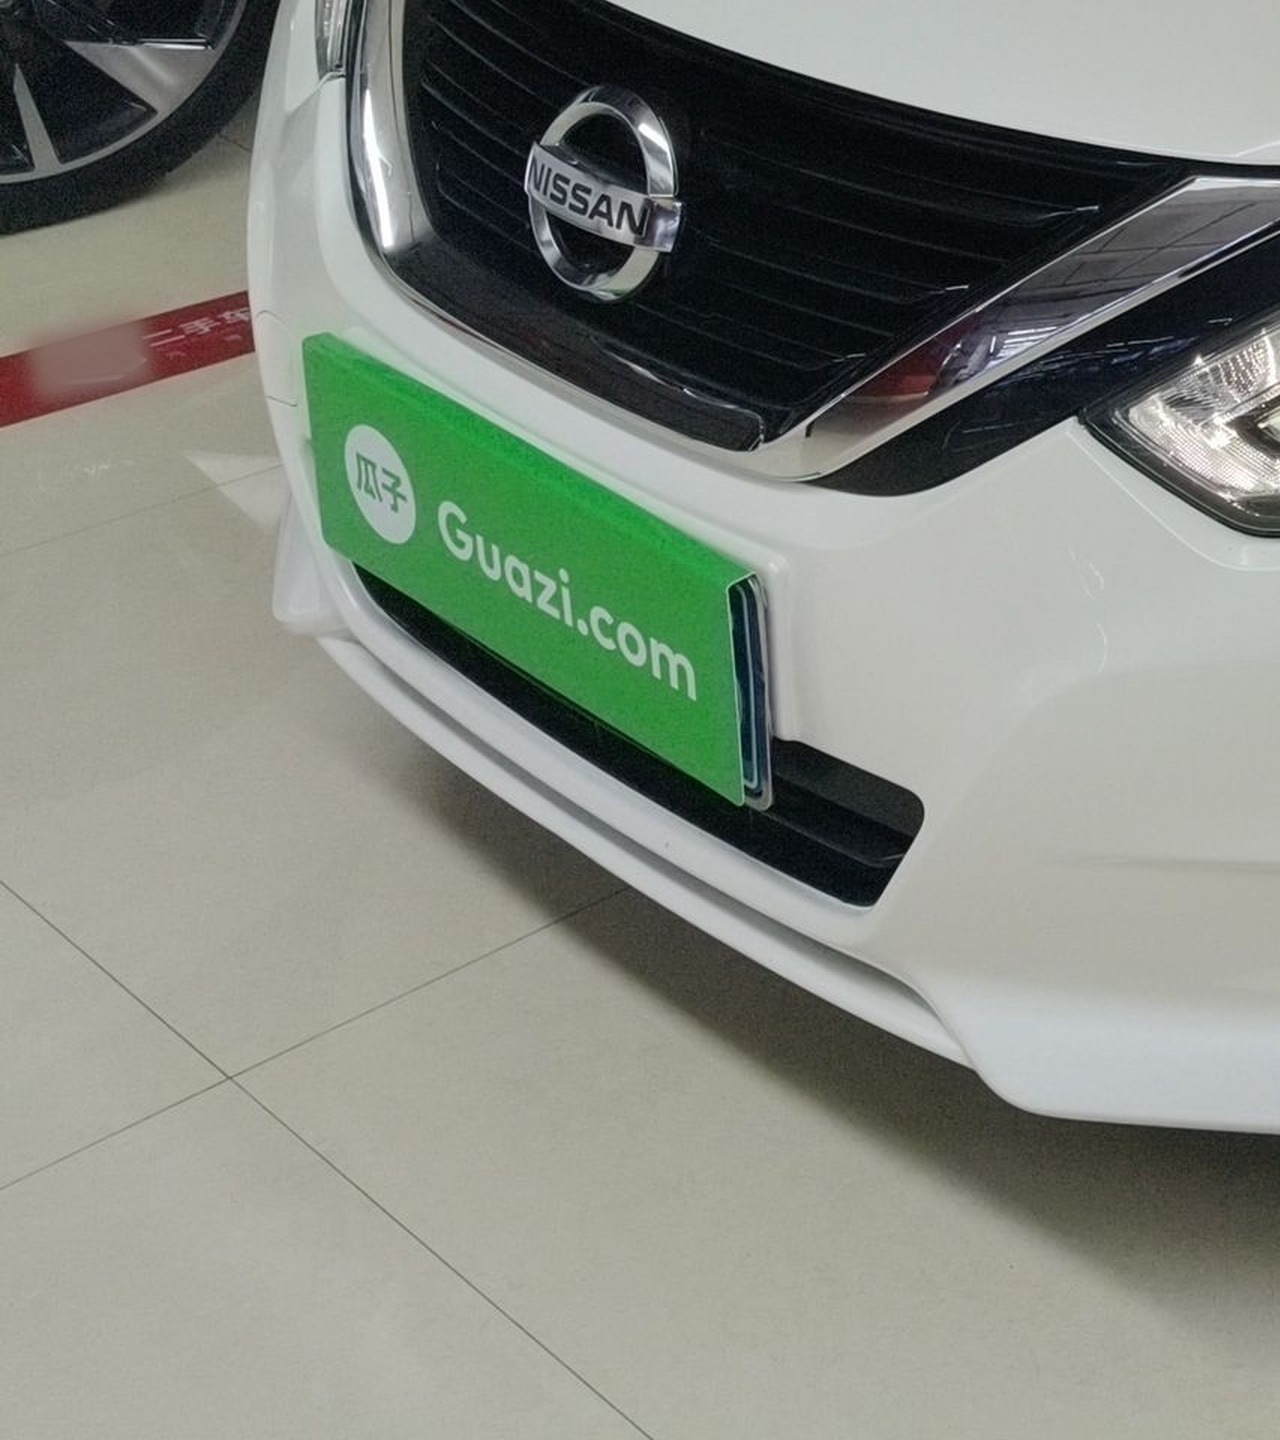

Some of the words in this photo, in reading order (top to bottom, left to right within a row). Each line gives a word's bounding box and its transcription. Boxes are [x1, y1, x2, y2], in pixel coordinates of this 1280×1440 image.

[528, 155, 651, 237] NISSAN
[355, 451, 408, 514] 瓜子
[437, 501, 697, 701] Guazi.com
